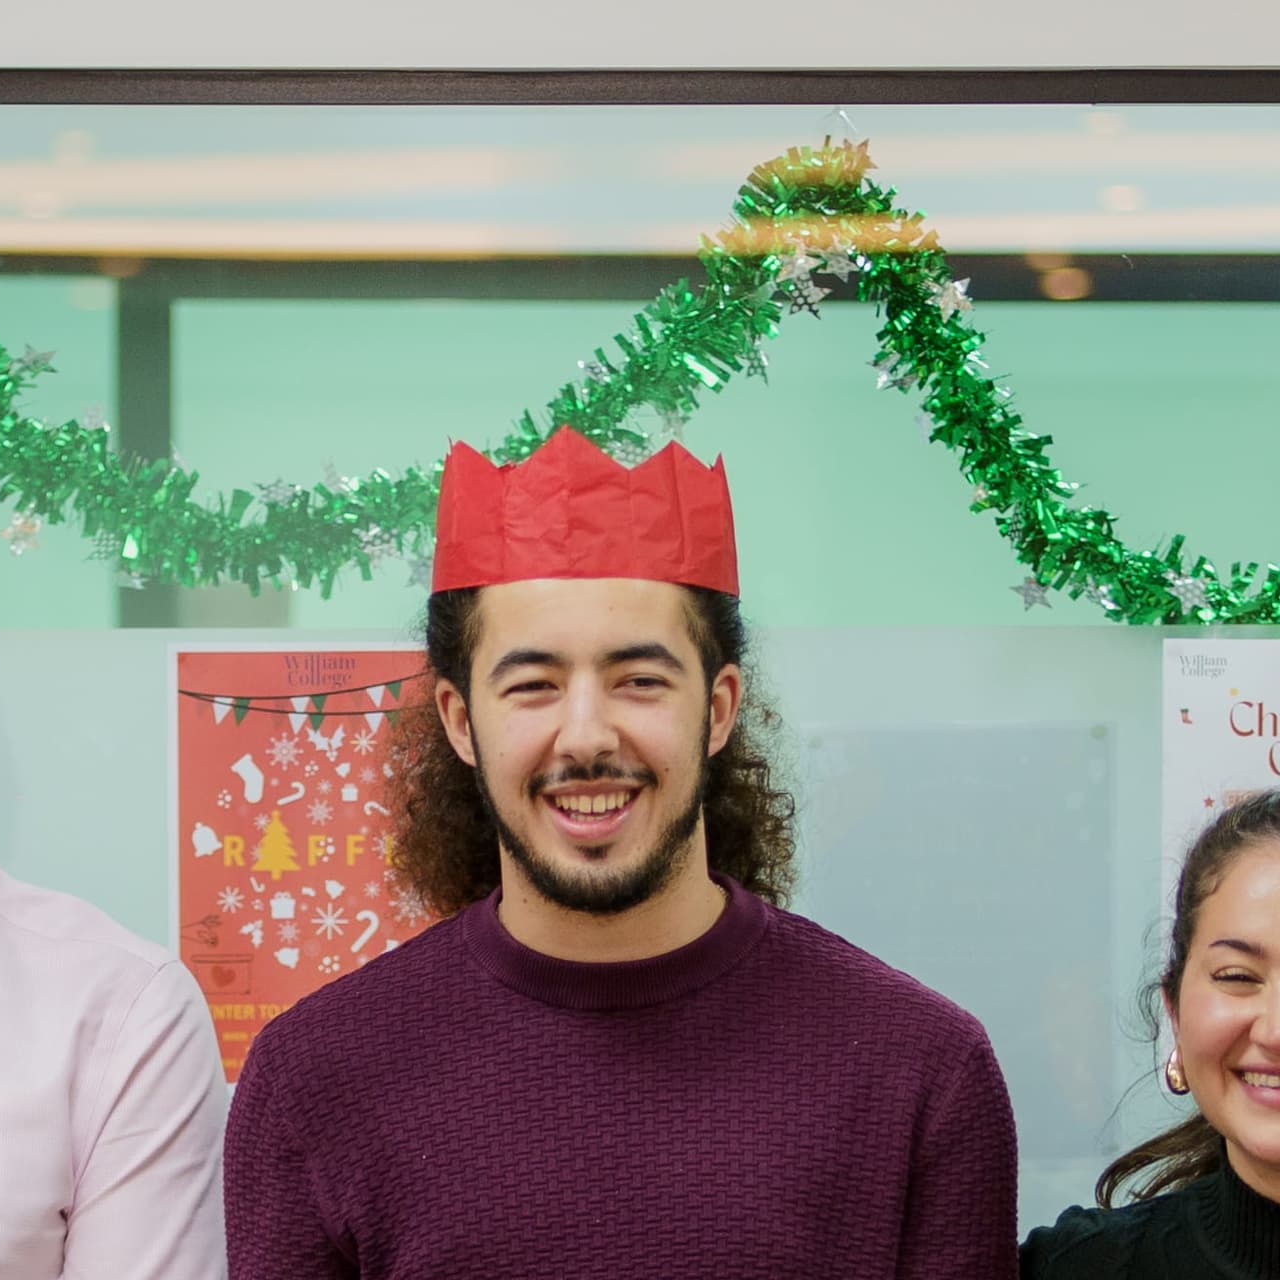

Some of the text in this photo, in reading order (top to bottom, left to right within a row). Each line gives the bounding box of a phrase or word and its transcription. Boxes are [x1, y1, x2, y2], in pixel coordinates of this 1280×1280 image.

[284, 655, 356, 670] William
[1179, 655, 1228, 667] William
[287, 671, 351, 688] College
[1181, 667, 1225, 680] College
